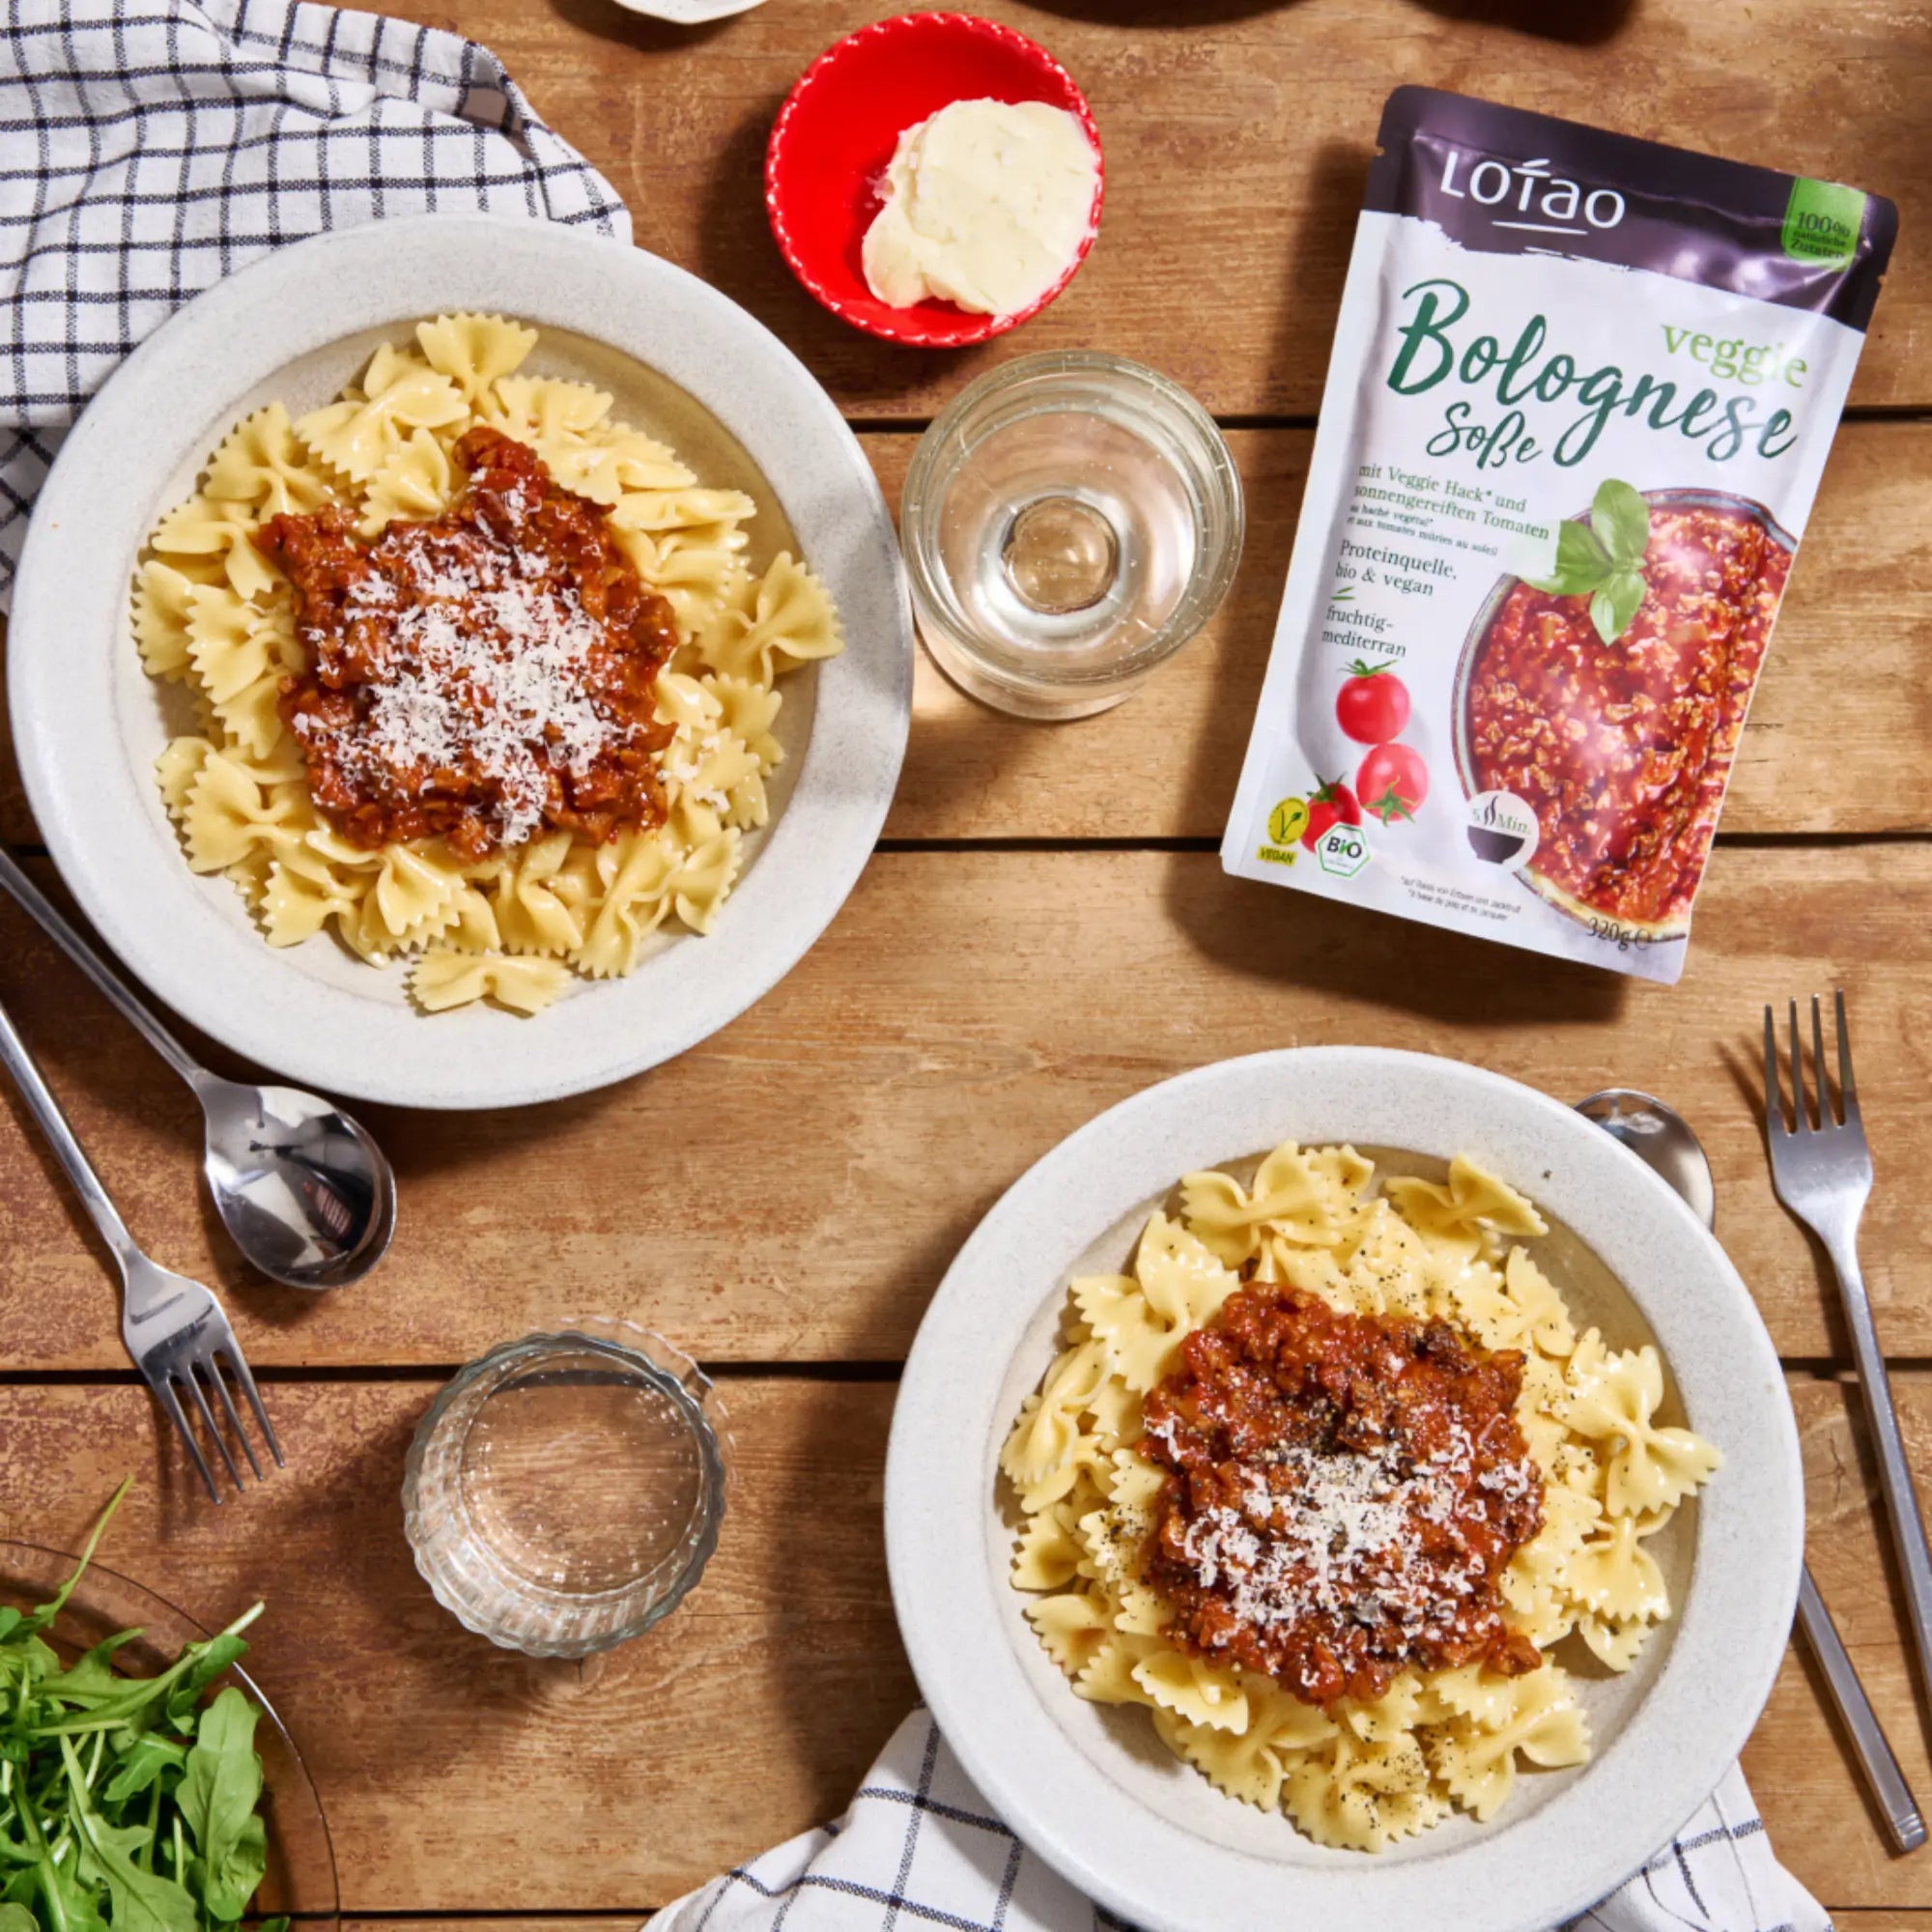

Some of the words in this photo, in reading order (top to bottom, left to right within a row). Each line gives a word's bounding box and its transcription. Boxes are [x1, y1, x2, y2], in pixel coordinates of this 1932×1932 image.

[1798, 212, 1851, 238] 100%
[1387, 277, 1798, 468] Bolognese
[1662, 324, 1807, 388] veggie
[1426, 400, 1543, 469] Soße
[1358, 464, 1381, 478] mit
[1388, 467, 1440, 493] Veggie
[1495, 495, 1527, 513] und
[1354, 485, 1476, 522] sonnengereiften
[1483, 510, 1549, 540] Tomaten
[1335, 561, 1357, 580] bio
[1361, 569, 1376, 583] &
[1383, 574, 1434, 596] vegan
[1325, 606, 1395, 634] fruchtig-
[1321, 630, 1406, 657] mediterran
[1261, 847, 1293, 865] VEGAN
[1586, 917, 1631, 952] 320g
